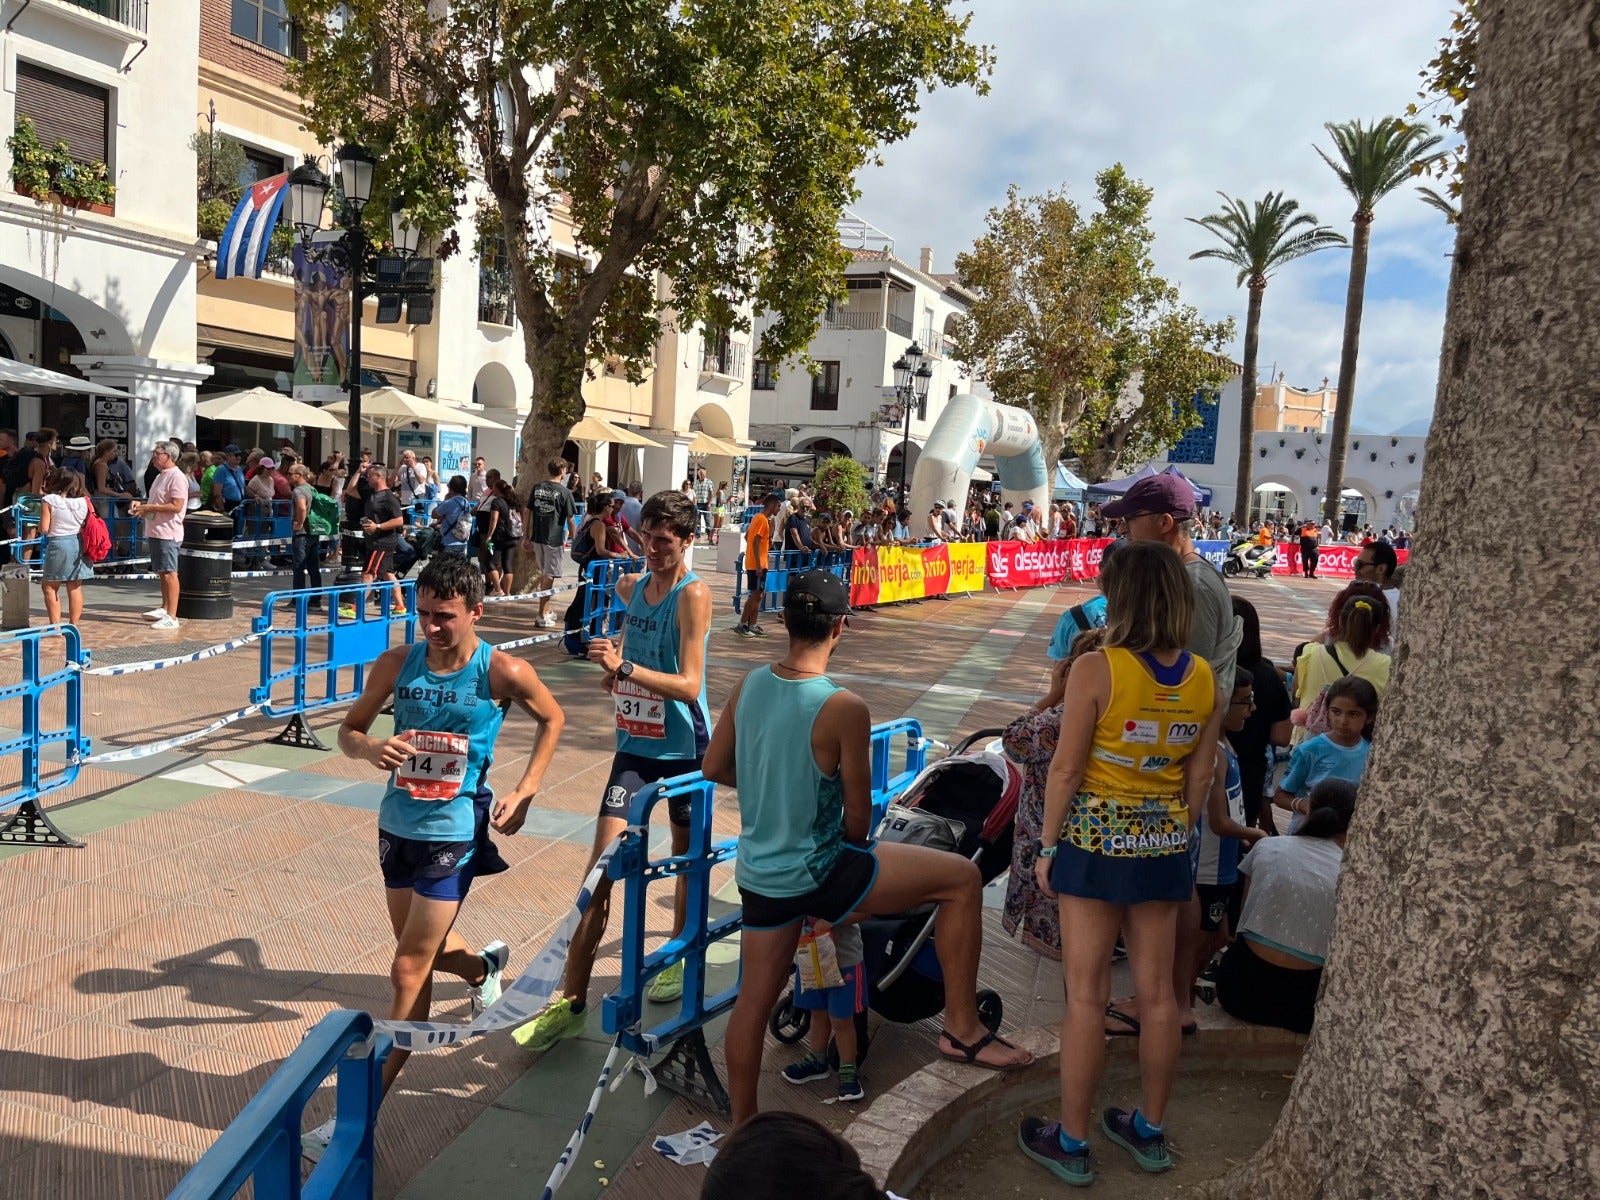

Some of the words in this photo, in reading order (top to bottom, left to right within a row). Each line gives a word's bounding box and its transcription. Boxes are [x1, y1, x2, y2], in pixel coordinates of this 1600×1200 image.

[442, 457, 460, 471] PIZZA
[853, 559, 877, 585] info
[923, 554, 948, 578] info
[398, 685, 459, 707] nerja
[622, 699, 640, 717] 31
[409, 734, 449, 752] ARCHA
[450, 737, 468, 754] 5K
[407, 755, 433, 774] 14
[1110, 831, 1188, 850] GRANADA
